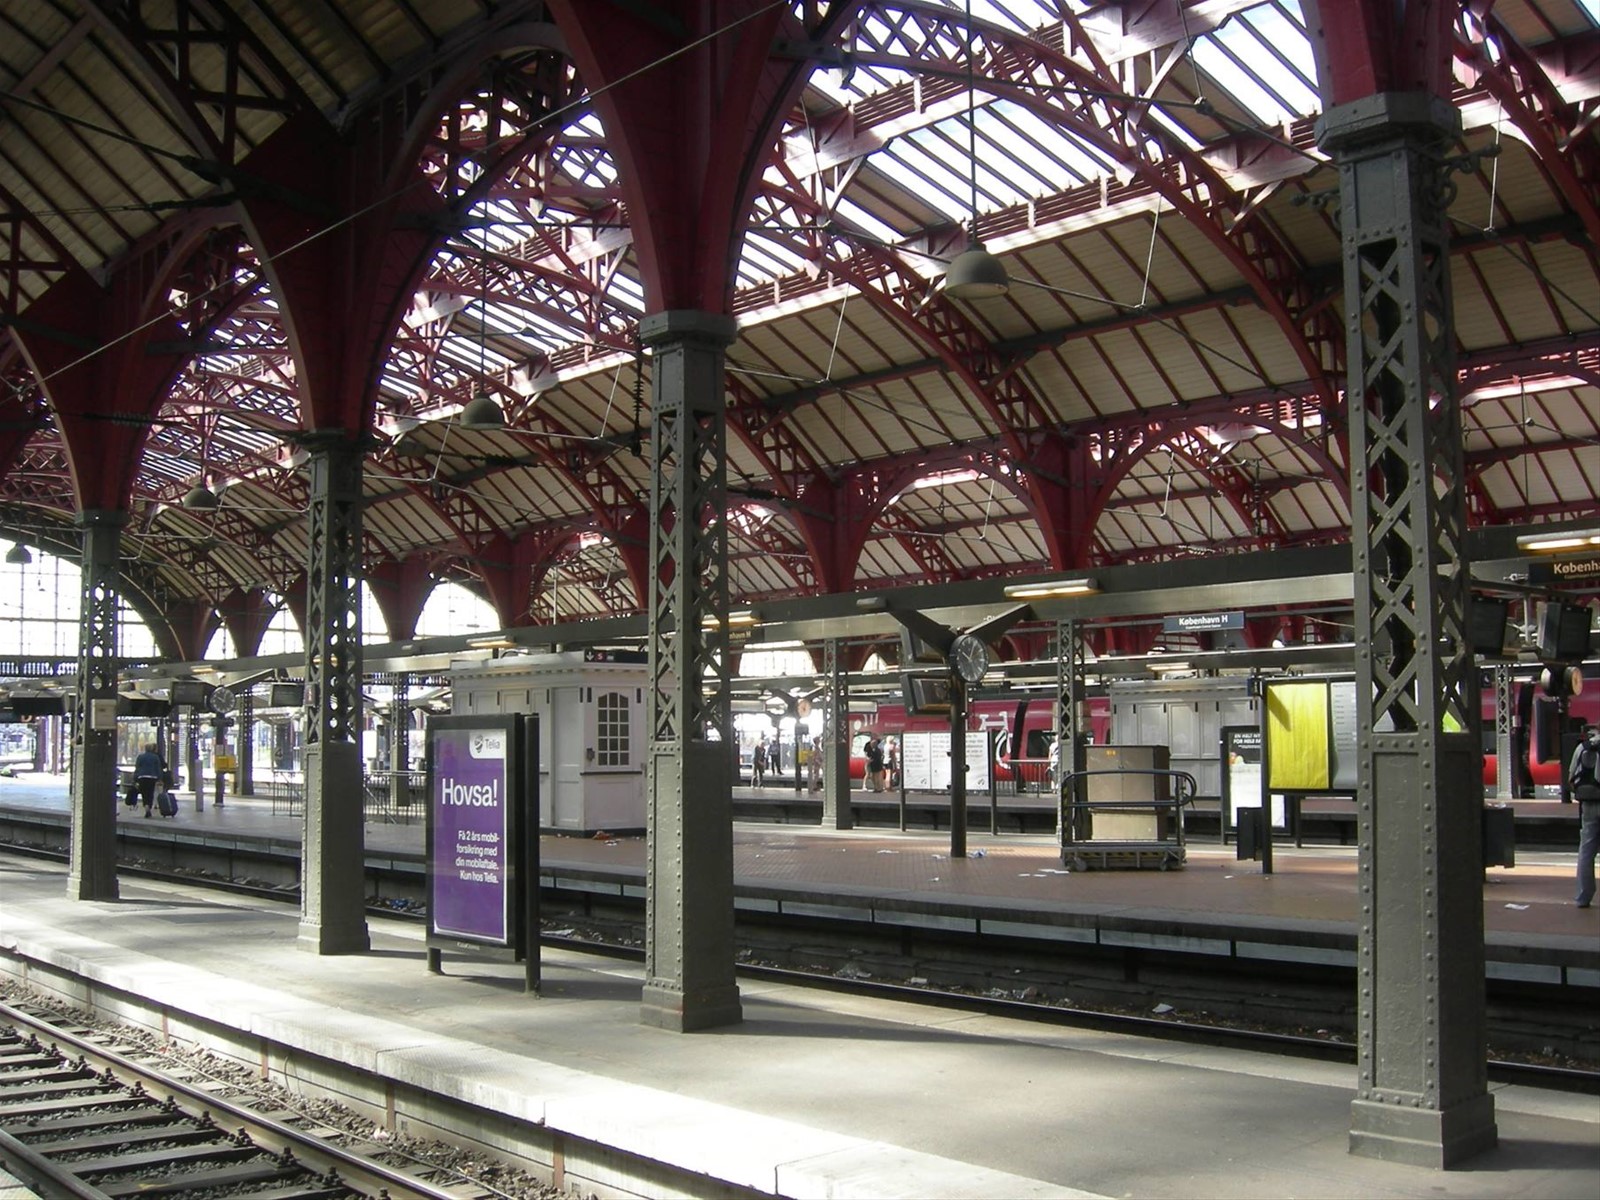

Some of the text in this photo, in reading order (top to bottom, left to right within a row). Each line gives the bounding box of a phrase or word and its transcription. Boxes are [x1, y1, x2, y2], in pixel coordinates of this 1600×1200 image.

[1553, 560, 1600, 575] Københ
[1178, 614, 1228, 626] København H
[485, 738, 501, 750] Telia
[442, 778, 498, 807] Hovsa!
[458, 829, 500, 843] Få 2 års mobil-
[456, 843, 498, 857] forsikring med
[455, 856, 499, 870] din mobilaftale.
[460, 870, 499, 884] Kun hos Telia.
